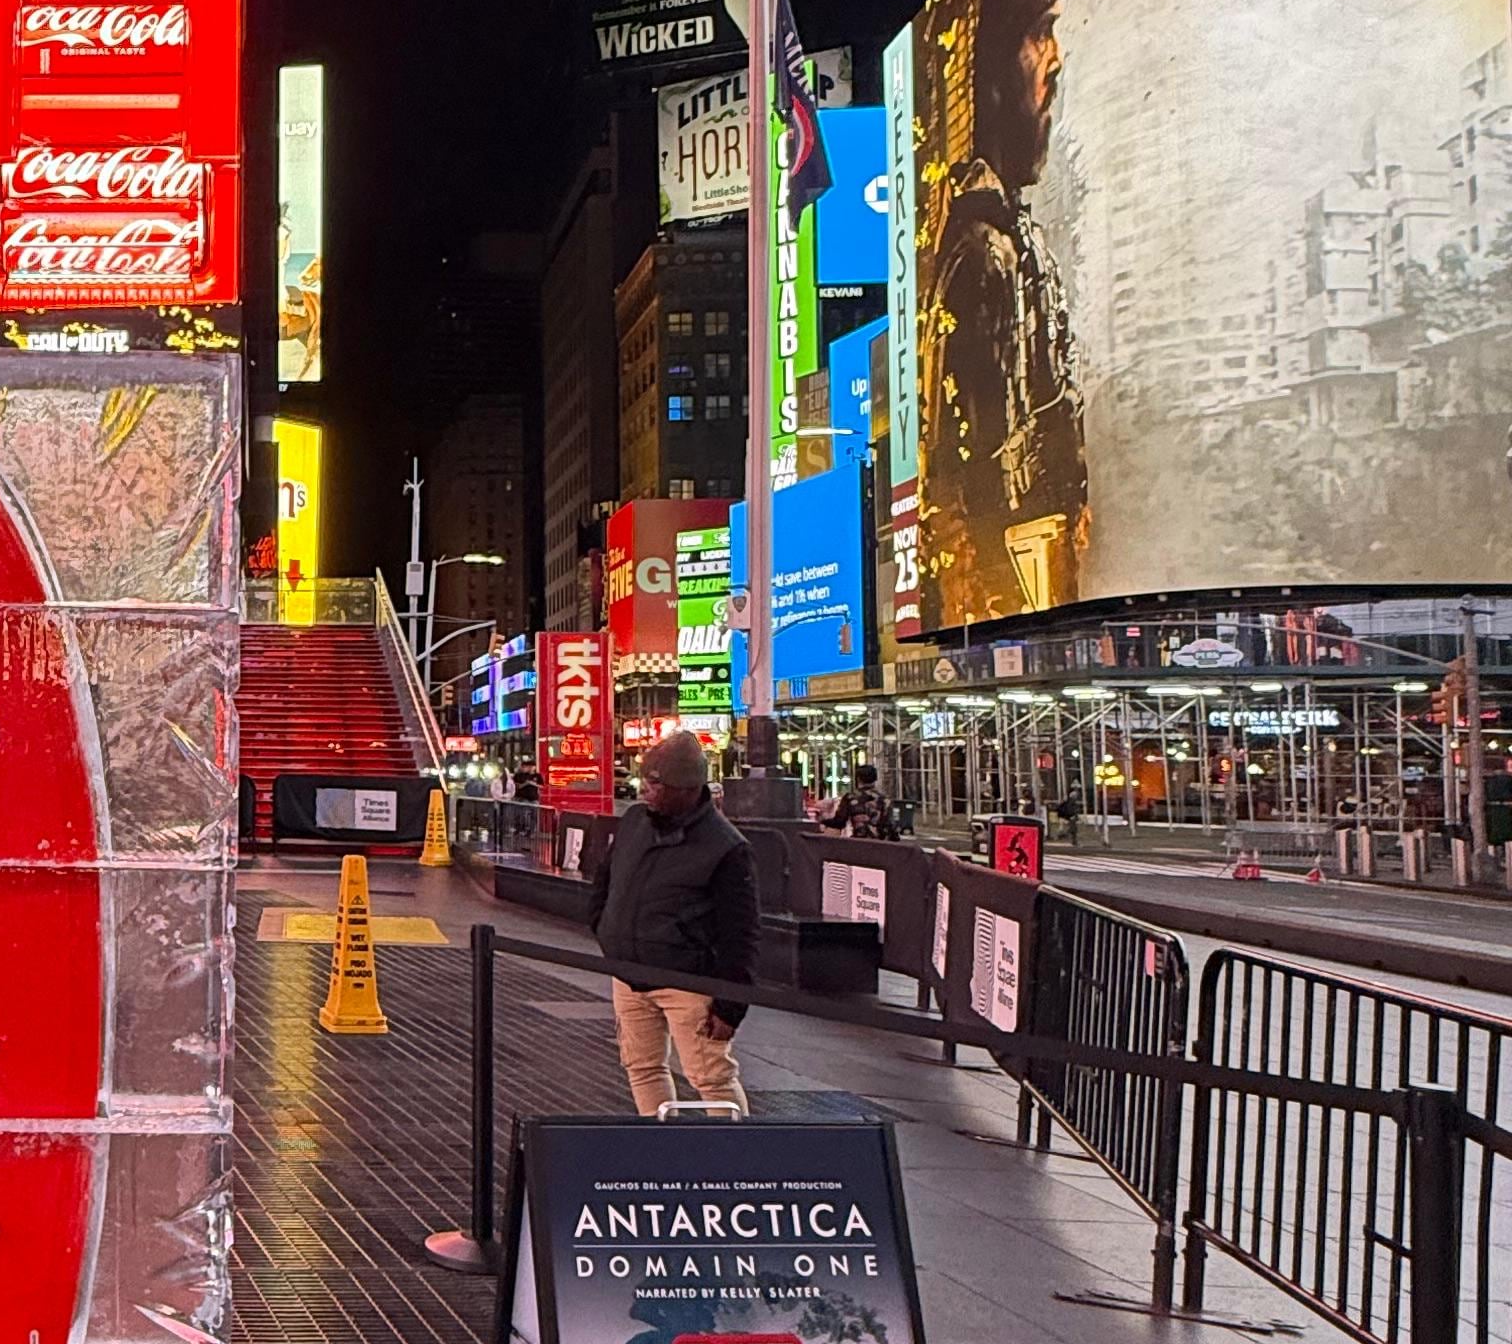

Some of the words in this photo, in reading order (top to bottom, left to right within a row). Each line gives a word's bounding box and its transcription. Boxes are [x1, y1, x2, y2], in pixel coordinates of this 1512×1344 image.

[61, 47, 110, 56] ORIGINAL
[114, 47, 146, 56] TASTE
[678, 73, 750, 130] LITTL
[678, 121, 750, 202] HOR
[893, 524, 918, 552] NOV
[803, 562, 839, 581] between
[894, 548, 920, 593] 25
[609, 559, 633, 606] FIVE
[806, 585, 830, 602] when
[557, 638, 601, 728] tkts
[1209, 710, 1281, 728] CETRAL
[856, 896, 880, 913] Square
[594, 1181, 639, 1190] GAUCHOS
[643, 1181, 659, 1190] DEL
[662, 1181, 682, 1190] MAR
[692, 1181, 700, 1190] A
[702, 1181, 730, 1190] SMALL
[734, 1181, 777, 1190] COMPANY
[783, 1181, 842, 1190] PRODUCTION
[574, 1204, 872, 1238] ANTARCTICA
[576, 1256, 756, 1277] DOMAIN
[794, 1255, 879, 1277] ONE
[636, 1288, 697, 1299] NARRATED
[701, 1289, 715, 1299] BY
[720, 1287, 761, 1299] KELLY
[769, 1287, 821, 1299] SLATER
